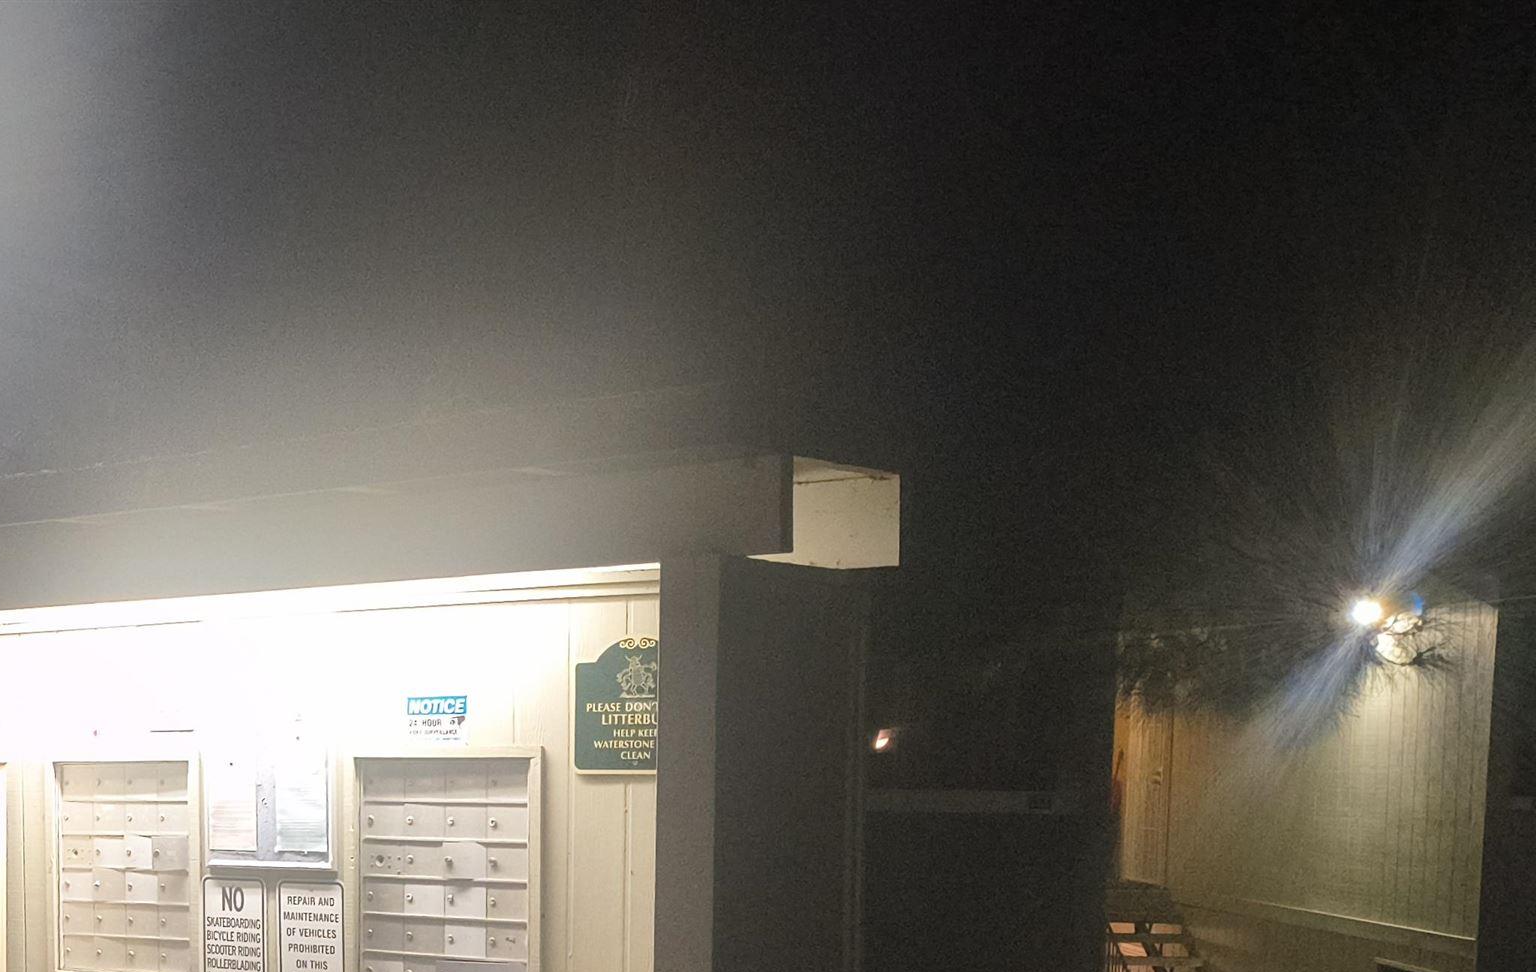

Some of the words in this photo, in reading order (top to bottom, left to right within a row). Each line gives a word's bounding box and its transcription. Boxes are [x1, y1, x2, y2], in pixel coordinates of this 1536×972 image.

[408, 698, 465, 714] NOTICE
[586, 702, 622, 712] PLEASE
[422, 718, 442, 727] HOUR
[613, 729, 635, 737] HELP
[593, 739, 654, 749] WATERSTONE
[620, 751, 651, 760] CLEAN
[221, 886, 245, 912] NO
[287, 895, 316, 906] REPAIR
[317, 897, 335, 907] AND
[206, 916, 261, 930] SKATEBOARDING
[283, 911, 340, 923] MAINTENANCE
[206, 930, 235, 942] BICYCLE
[236, 932, 261, 944] RIDING
[286, 927, 296, 937] OF
[298, 928, 337, 939] VEHICLES
[206, 943, 236, 956] SCOOTER
[237, 945, 261, 958] RIDING
[288, 943, 336, 955] PROHIBITED
[207, 957, 261, 972] ROLLERBLADING
[296, 959, 308, 969] ON
[310, 960, 328, 970] THIS
